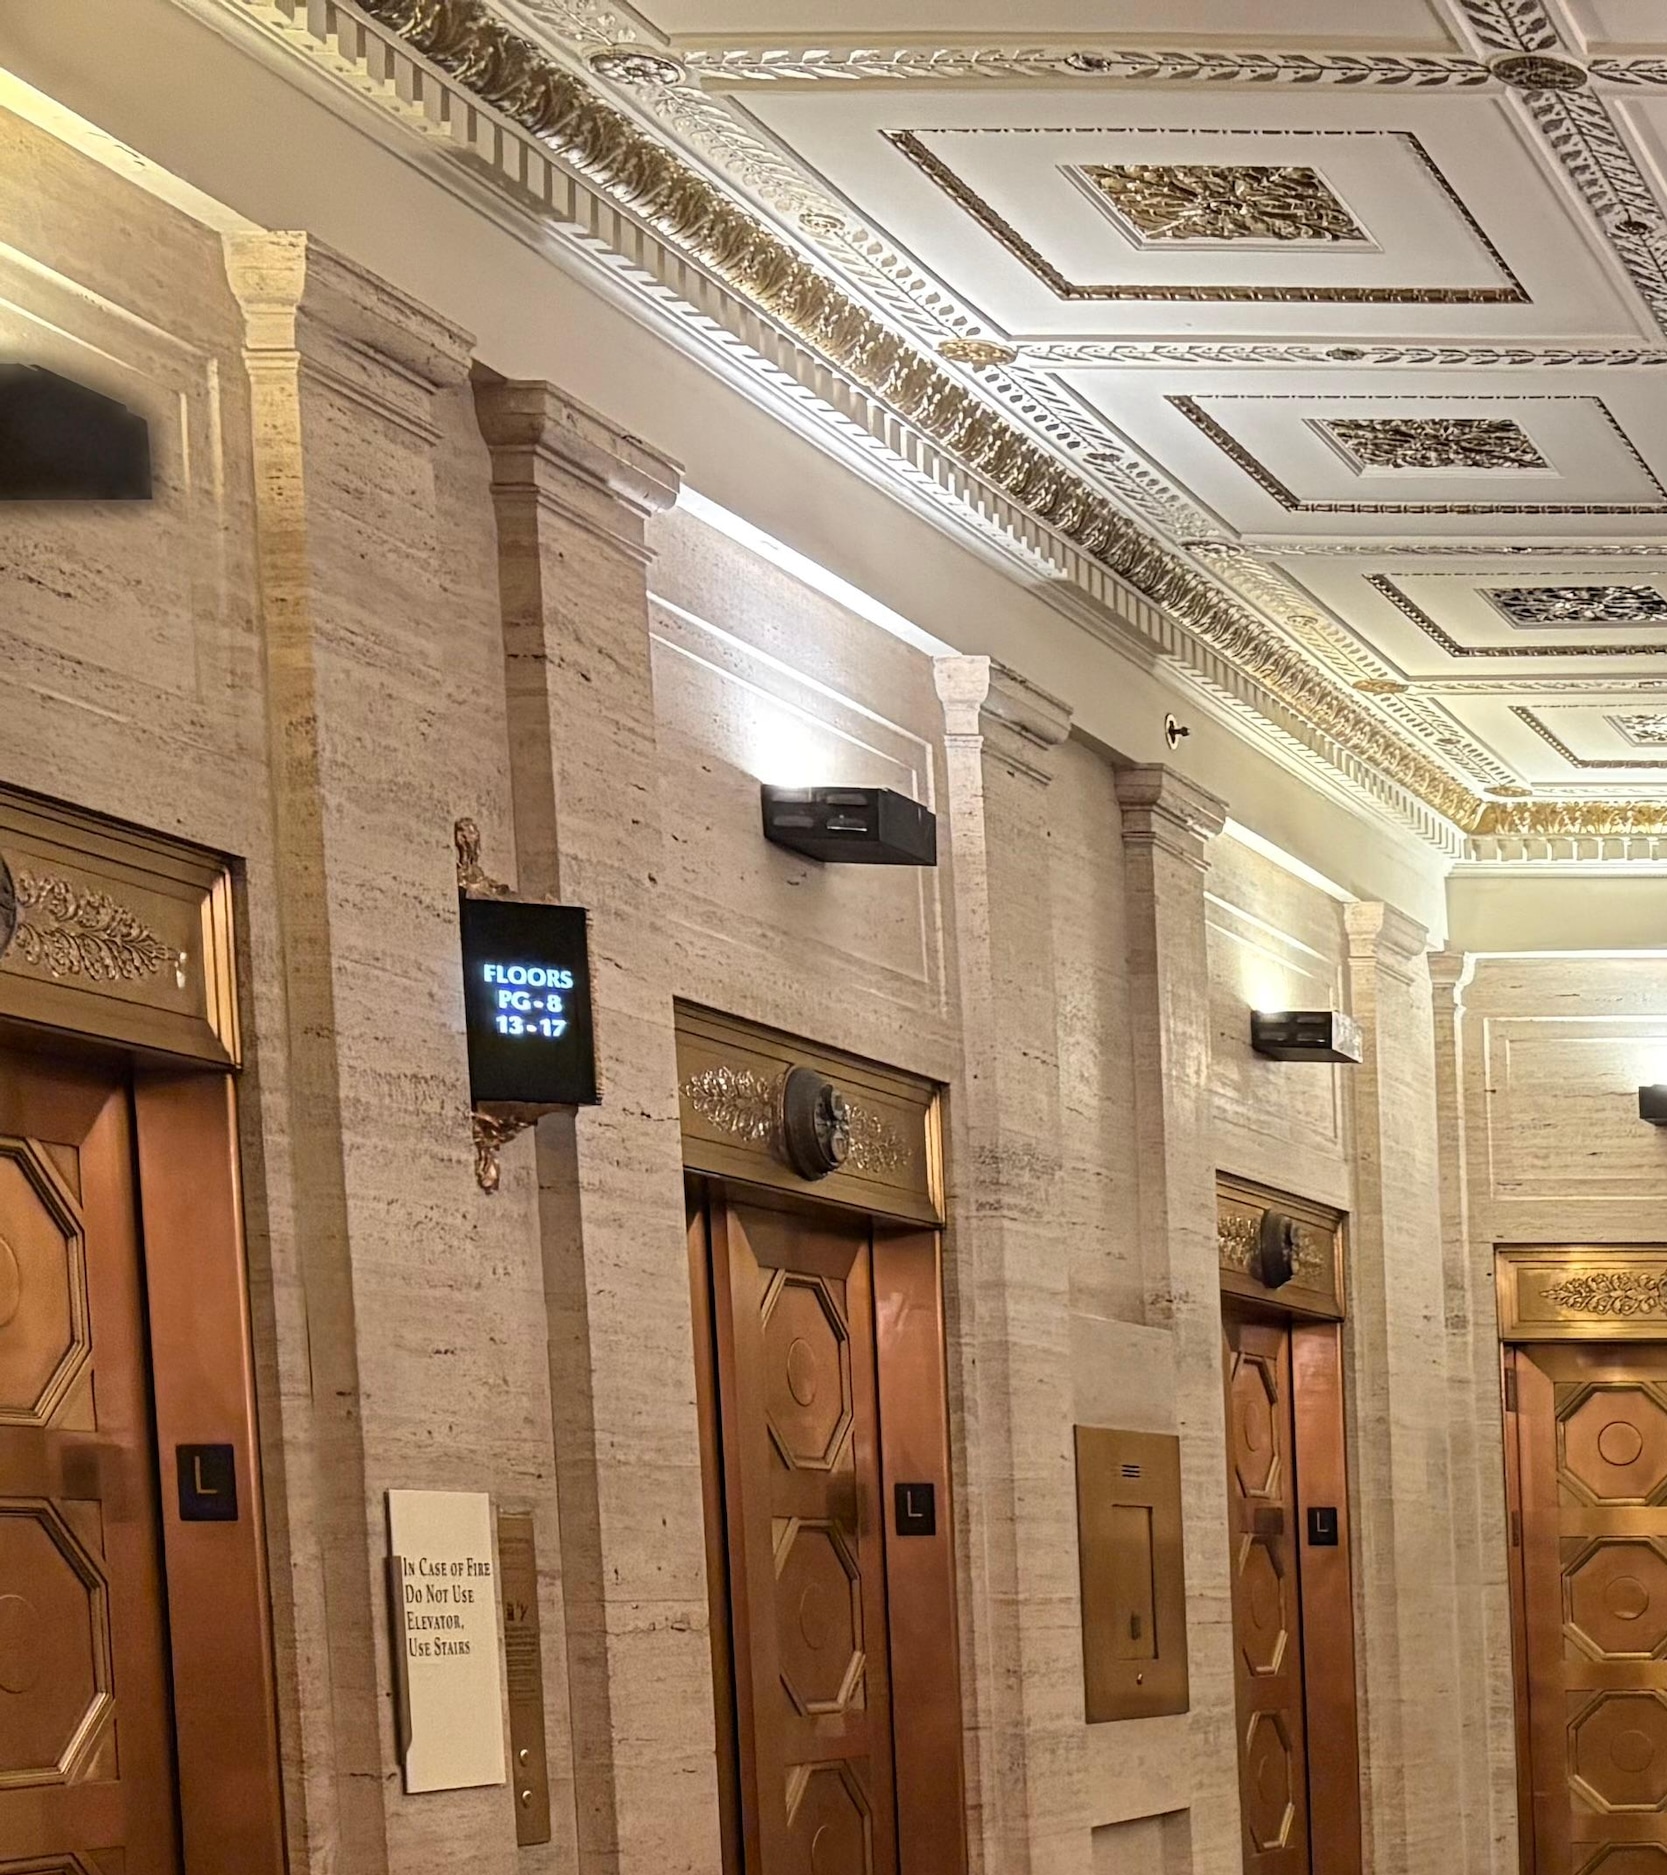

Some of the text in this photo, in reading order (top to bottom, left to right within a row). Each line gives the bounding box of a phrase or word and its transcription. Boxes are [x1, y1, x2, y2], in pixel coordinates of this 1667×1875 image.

[483, 963, 574, 989] FLOORS
[194, 1455, 218, 1494] L
[907, 1490, 923, 1517] L
[1316, 1511, 1329, 1533] L
[403, 1557, 491, 1576] IN CASE OF FIRE
[405, 1584, 475, 1603] DO NOT USE
[407, 1611, 464, 1630] ELEVATOR,
[408, 1636, 471, 1657] USE STAIRS
